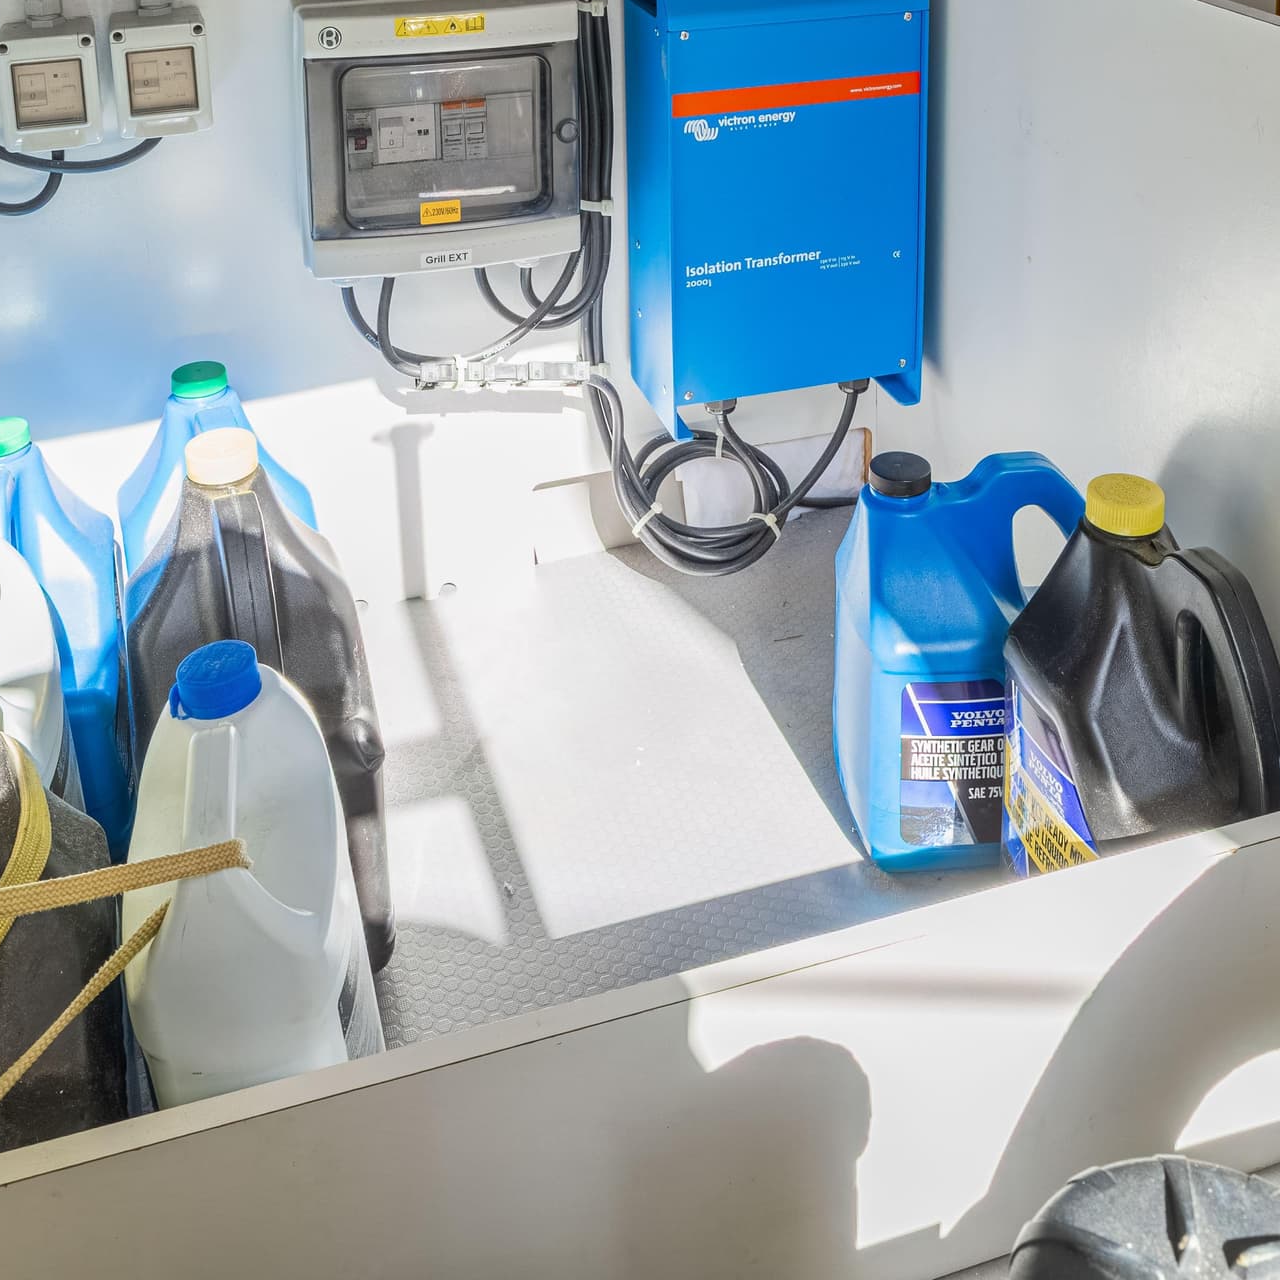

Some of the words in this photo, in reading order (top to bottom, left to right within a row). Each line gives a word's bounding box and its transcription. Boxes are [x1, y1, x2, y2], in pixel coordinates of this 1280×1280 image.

[718, 114, 756, 127] victron
[758, 111, 796, 123] energy
[425, 255, 446, 264] Grill
[449, 252, 469, 262] EXT
[686, 261, 742, 278] Isolation
[744, 249, 821, 269] Transformer
[951, 709, 1005, 720] VOLVO
[950, 718, 1005, 728] PENTA
[911, 740, 966, 753] SYNTHETIC
[967, 739, 994, 753] GEAR
[911, 753, 945, 767] ACEITE
[911, 767, 940, 780] HUILE
[968, 787, 986, 800] SAE
